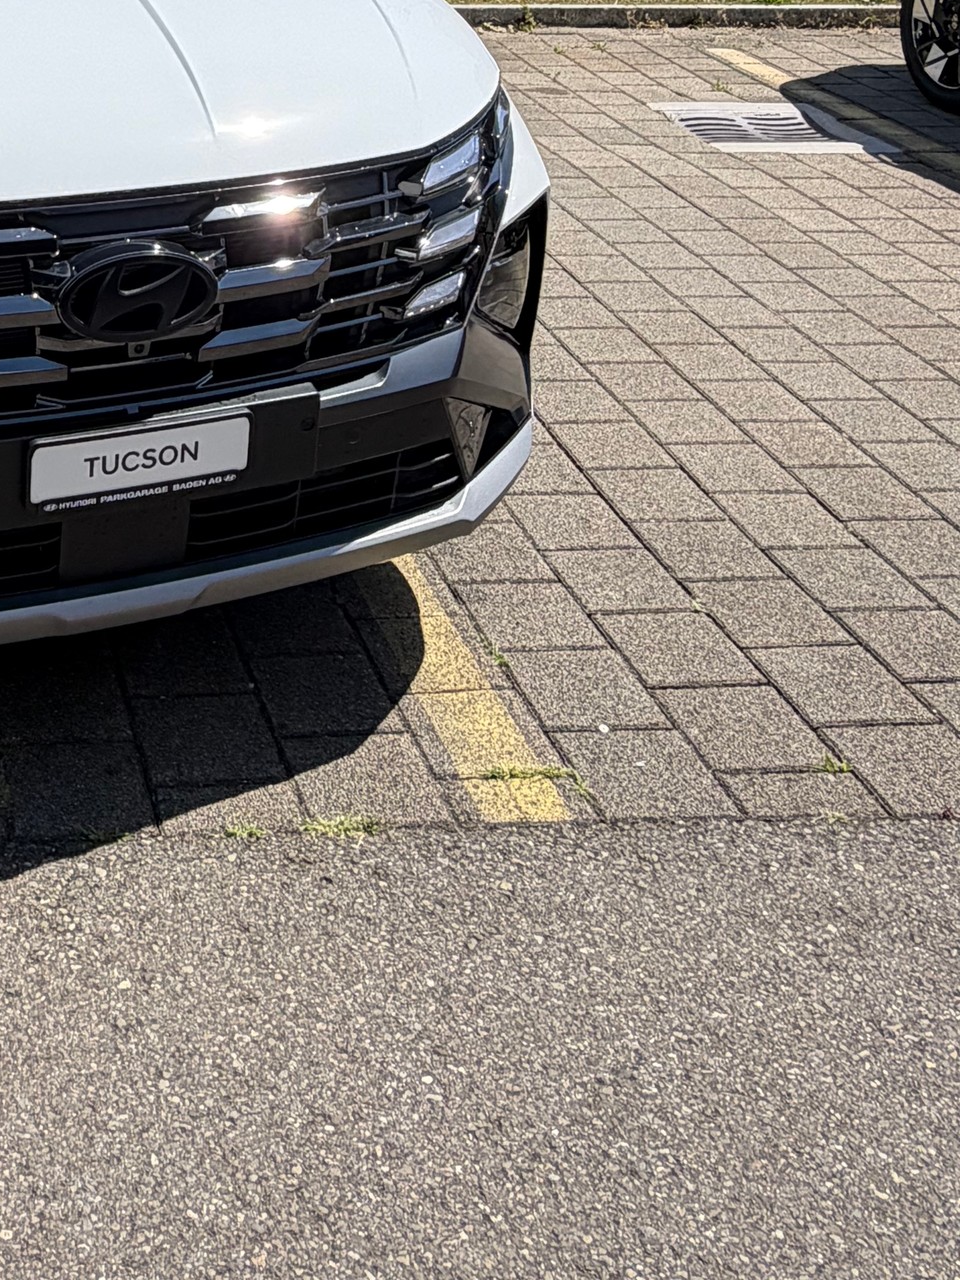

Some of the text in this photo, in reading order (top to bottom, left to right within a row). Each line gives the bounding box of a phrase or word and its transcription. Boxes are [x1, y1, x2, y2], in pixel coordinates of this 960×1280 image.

[84, 441, 199, 478] TUCSON
[100, 485, 169, 504] PARKGARAGE
[172, 478, 206, 491] BADEN
[208, 476, 222, 486] AG
